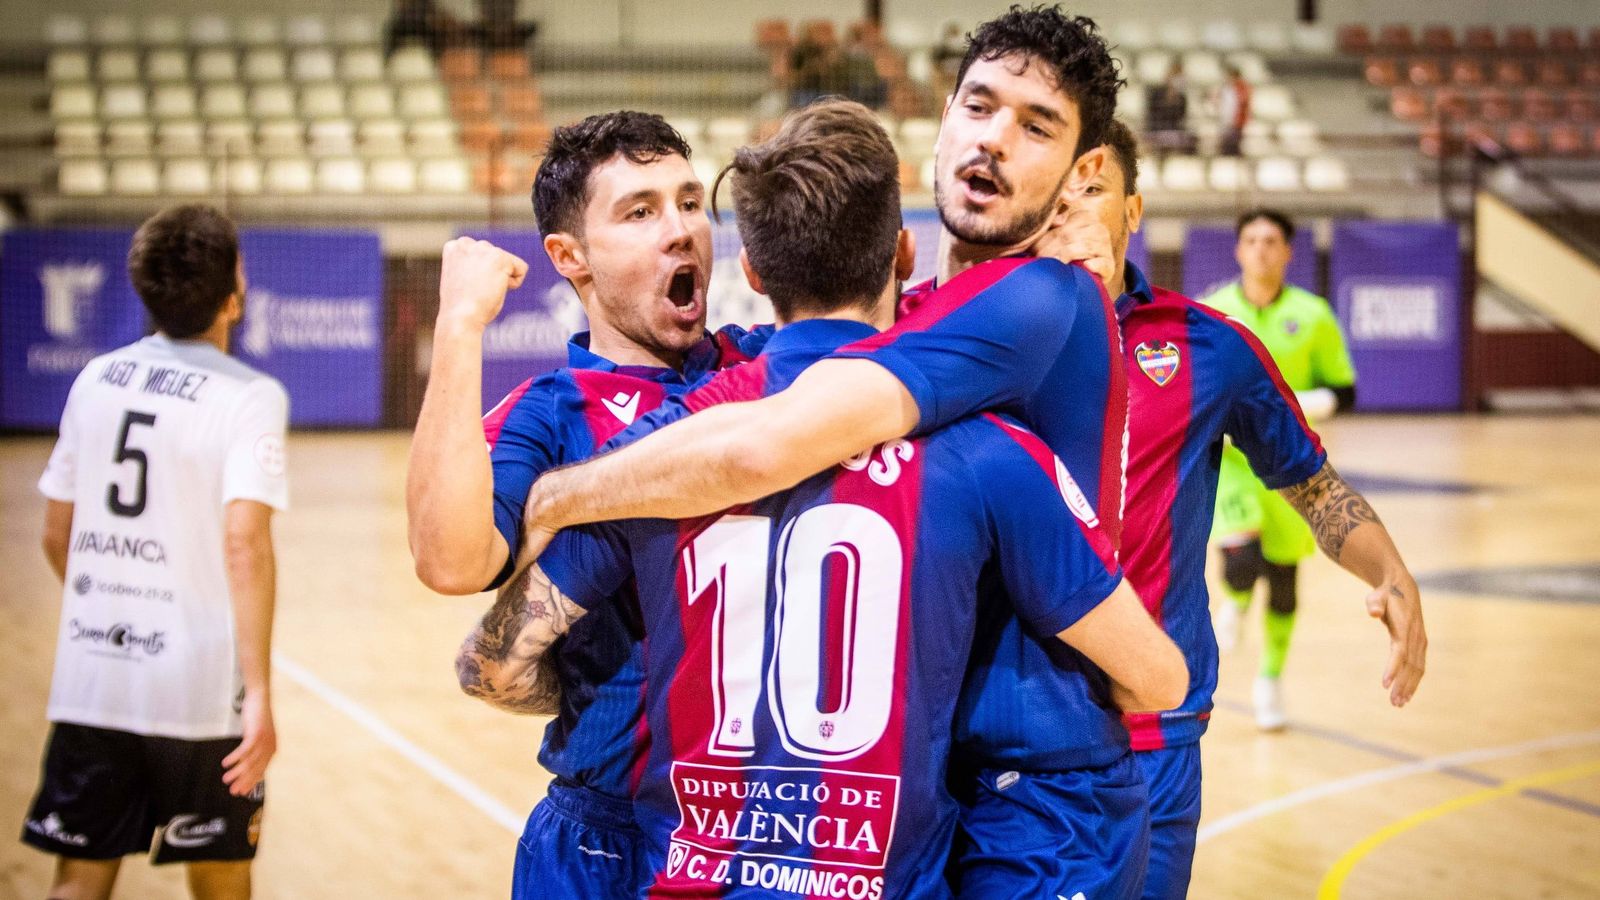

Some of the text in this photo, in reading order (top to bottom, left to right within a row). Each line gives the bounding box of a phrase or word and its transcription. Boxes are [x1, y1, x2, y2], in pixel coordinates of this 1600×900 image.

[106, 409, 156, 517] 5
[682, 502, 903, 762] 10
[681, 777, 882, 809] DIPUTACIÓ DE
[687, 804, 881, 853] VALÈNCIA
[686, 854, 885, 900] C. D. DOMINICOS
